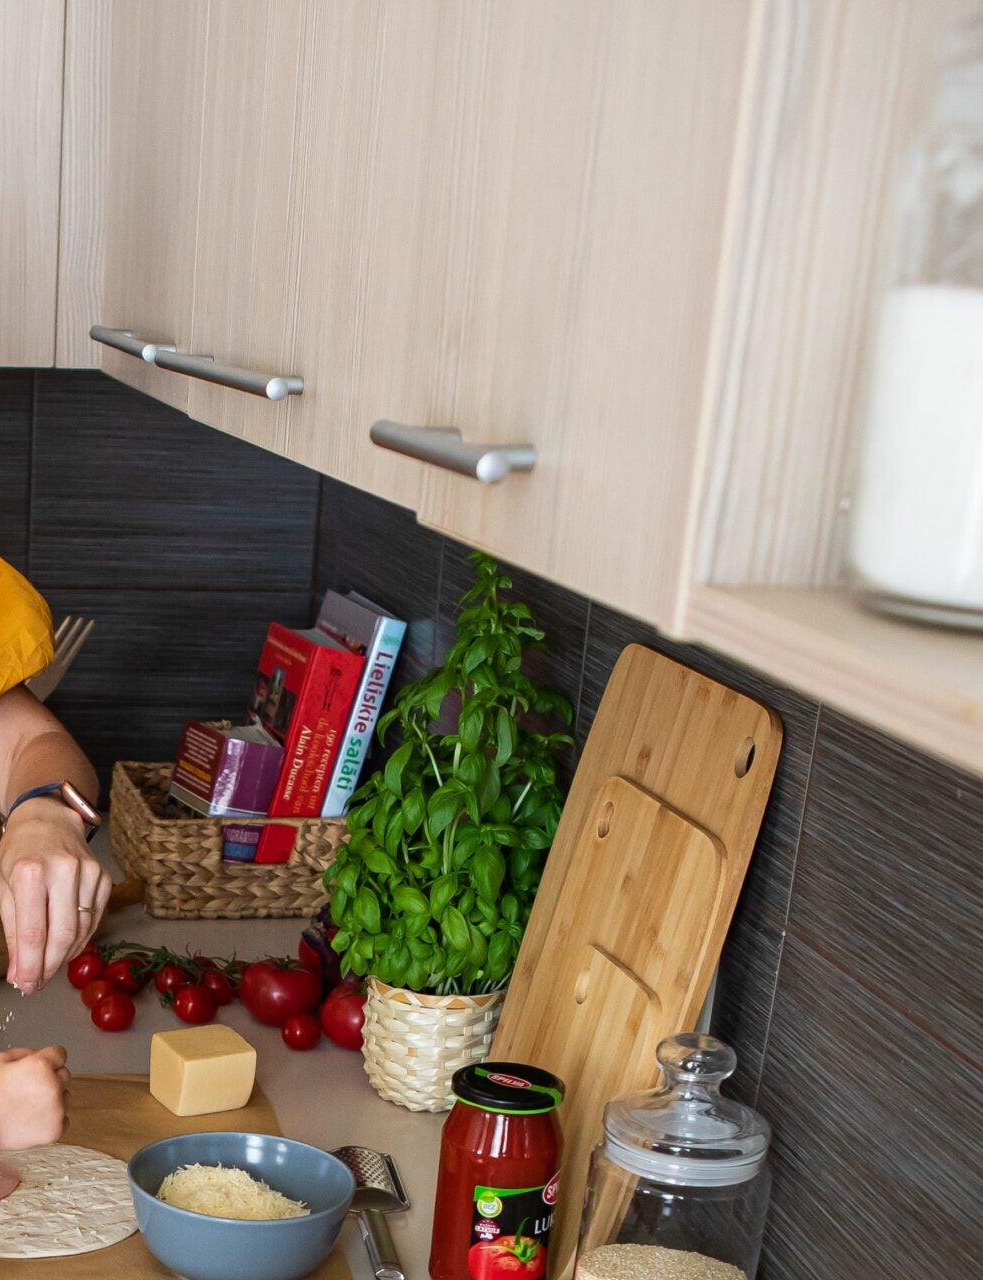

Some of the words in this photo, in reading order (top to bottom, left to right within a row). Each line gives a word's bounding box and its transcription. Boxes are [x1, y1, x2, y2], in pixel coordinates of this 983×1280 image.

[354, 651, 393, 734] Lieliskie
[296, 725, 313, 756] Alain
[283, 758, 304, 800] Ducasse
[312, 749, 331, 793] recepten
[336, 738, 363, 791] salāti
